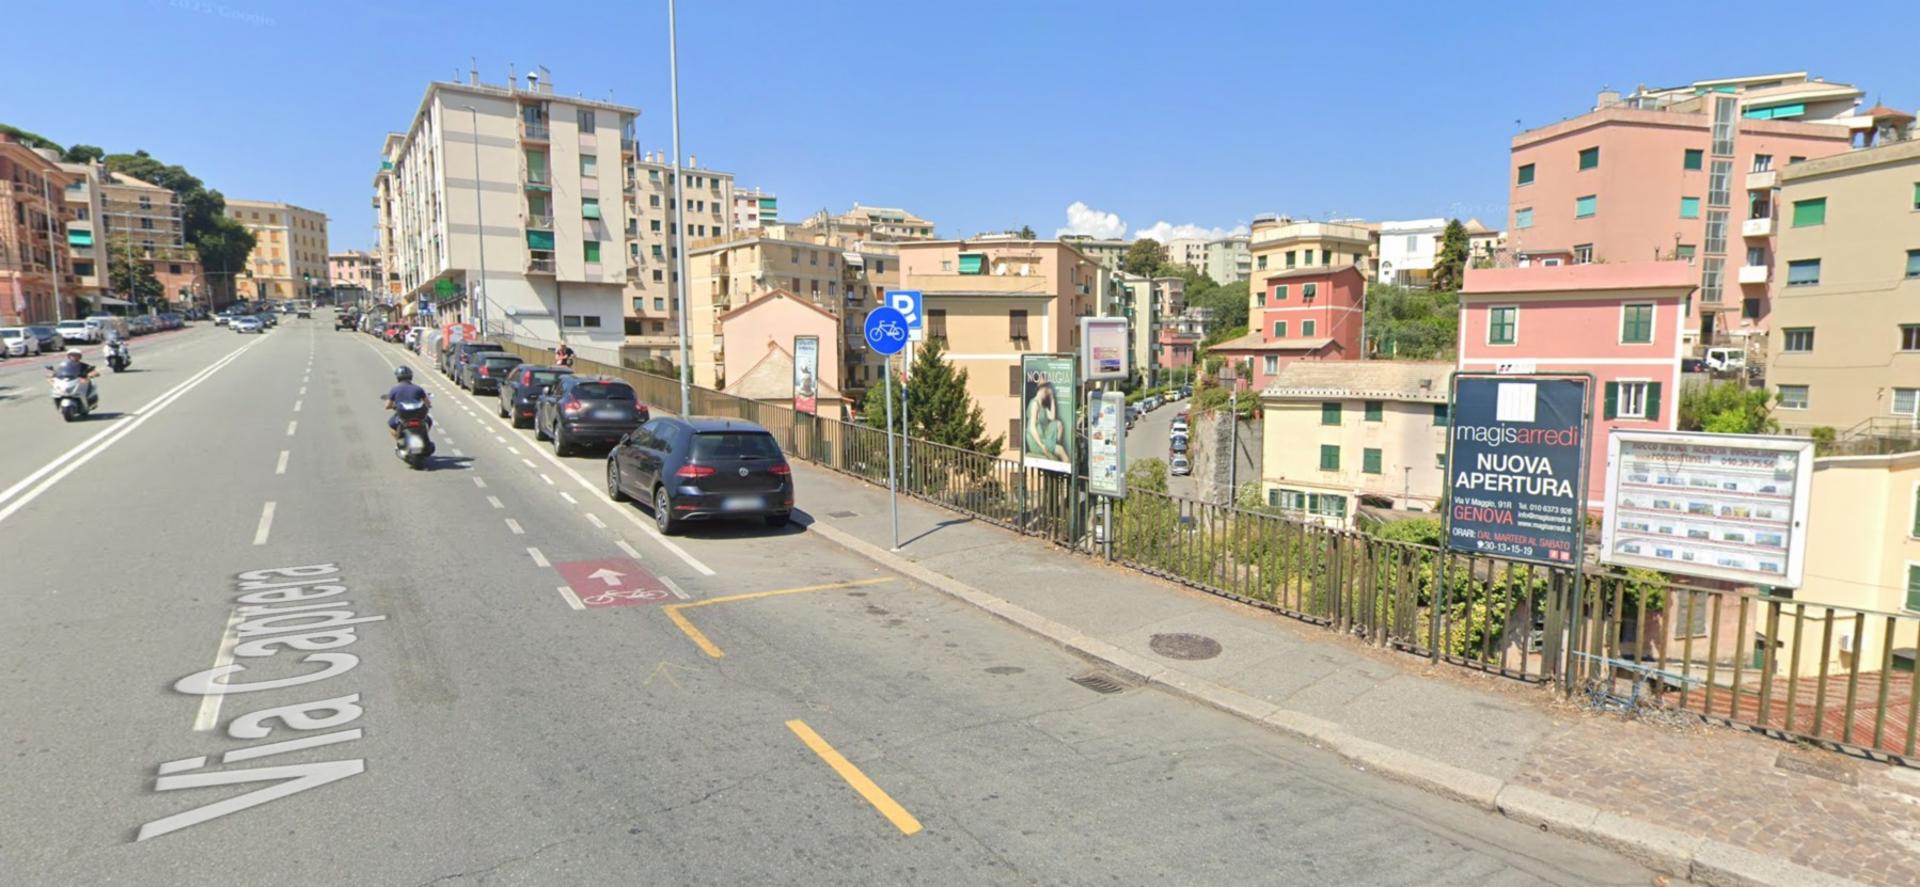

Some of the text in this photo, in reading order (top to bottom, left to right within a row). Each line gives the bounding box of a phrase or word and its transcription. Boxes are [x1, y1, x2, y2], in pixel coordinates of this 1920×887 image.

[1026, 370, 1072, 384] NOSTALGIA
[1456, 423, 1579, 447] magisarredi
[1477, 453, 1553, 475] NUOVA
[1455, 472, 1573, 498] APERTURA
[1454, 505, 1513, 525] GENOVA
[1452, 527, 1476, 538] ORARI:
[1477, 530, 1491, 540] DAL
[1539, 538, 1571, 550] SABATO
